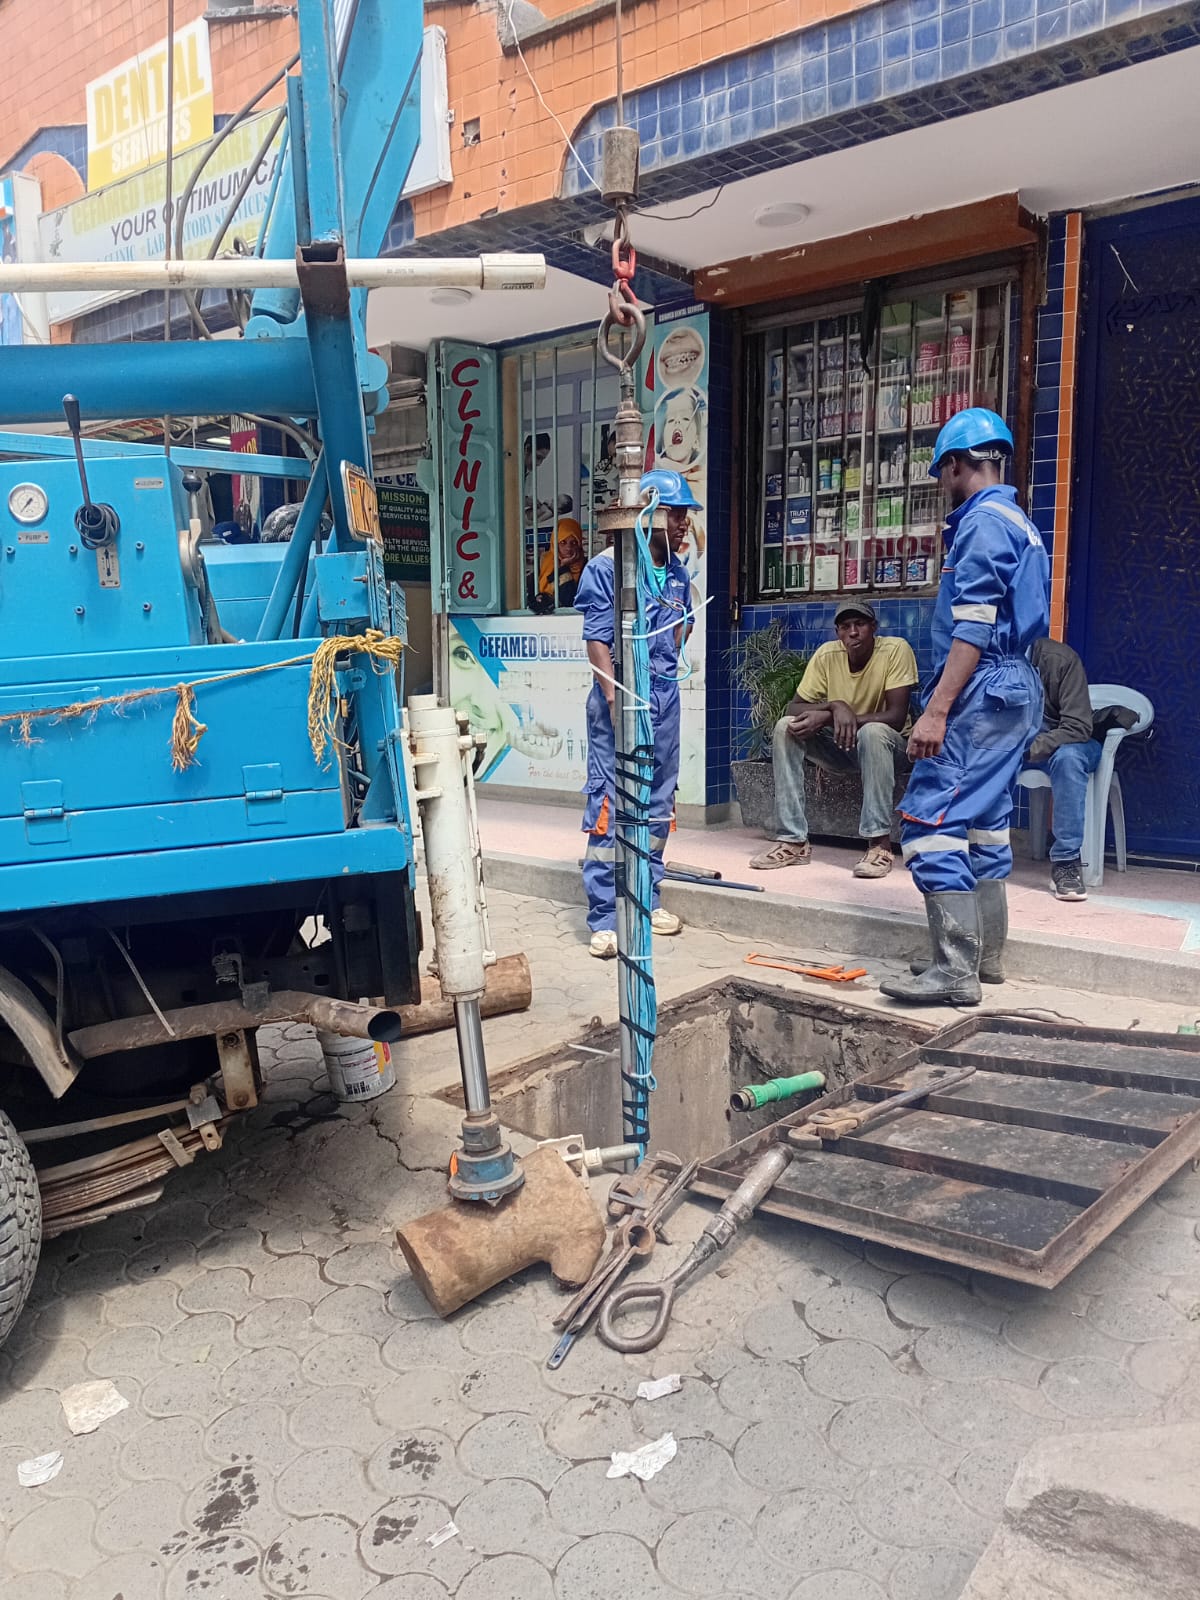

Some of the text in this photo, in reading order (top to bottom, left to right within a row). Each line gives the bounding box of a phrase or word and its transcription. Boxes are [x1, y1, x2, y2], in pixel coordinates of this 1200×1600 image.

[94, 31, 205, 145] DENTAL
[112, 107, 191, 174] SERVICES
[111, 209, 156, 246] YOUR
[452, 358, 481, 599] CLINIC &
[383, 512, 411, 520] SERVICES
[389, 505, 414, 513] QUALITY
[790, 510, 809, 518] TRUST
[401, 554, 430, 564] VALUES
[480, 635, 538, 658] CEFAMED
